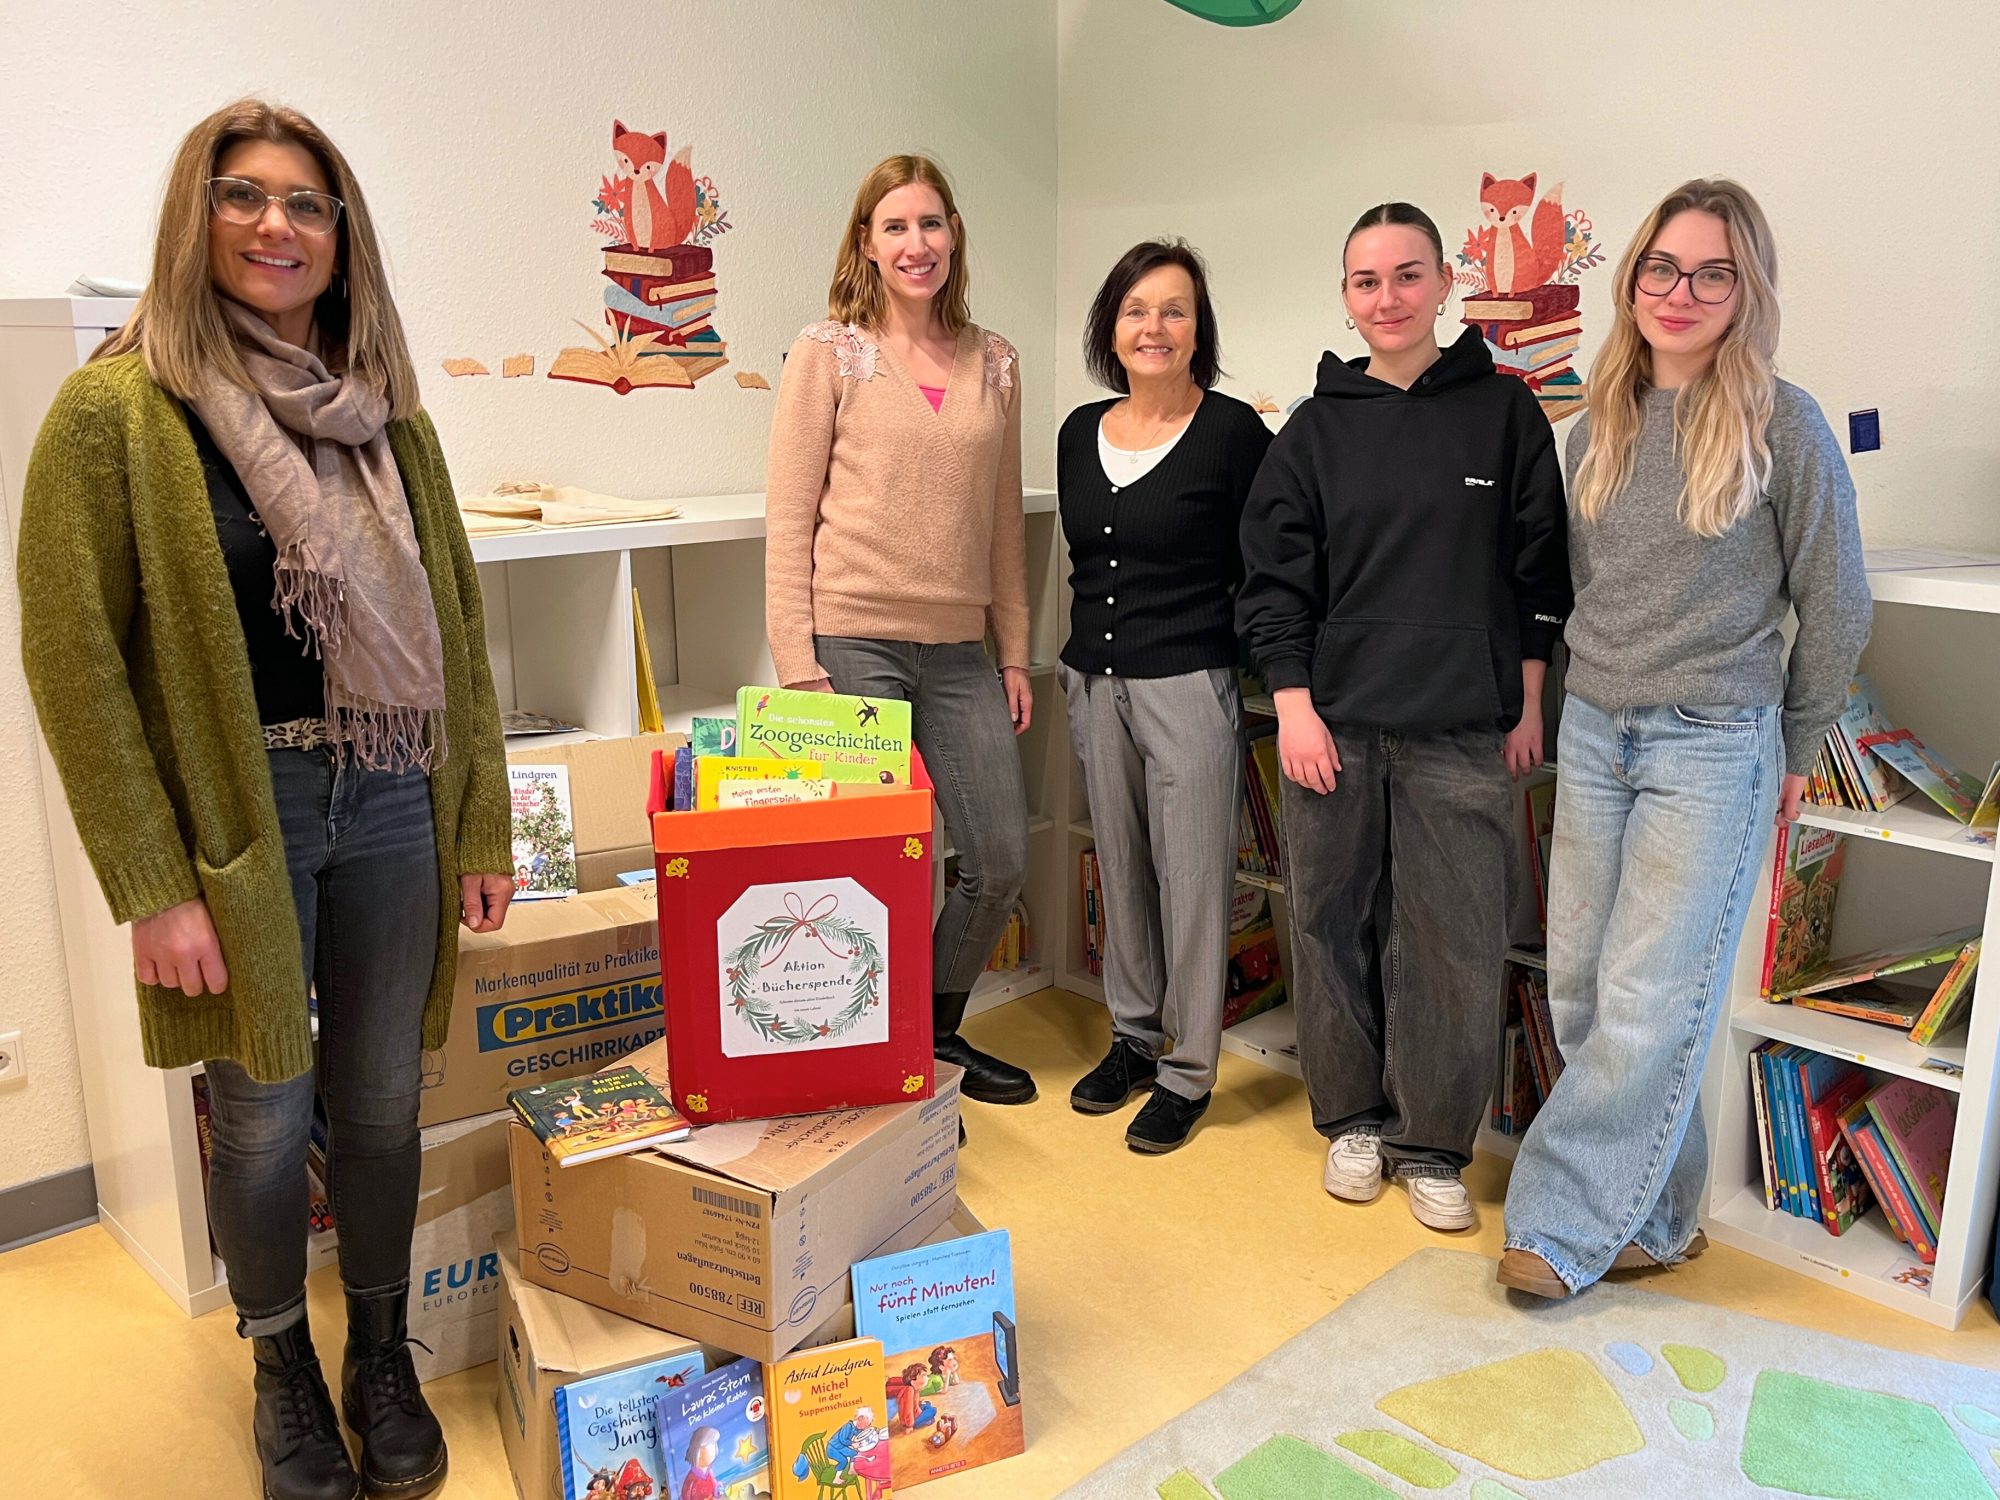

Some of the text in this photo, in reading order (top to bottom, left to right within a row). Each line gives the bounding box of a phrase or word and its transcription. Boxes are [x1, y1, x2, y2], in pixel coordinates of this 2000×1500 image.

[768, 713, 784, 724] Die
[750, 723, 903, 752] Zoogeschichten
[725, 765, 758, 773] KNISTER
[834, 751, 877, 765] Kinder
[511, 770, 557, 781] Lindgren
[513, 788, 535, 796] Kinder
[731, 785, 782, 798] Meine ersten
[1800, 829, 1836, 856] Lieselotte
[475, 946, 662, 994] Markenqualität zu Praktike
[783, 960, 826, 973] Aktion
[761, 975, 853, 994] Bücherspende
[196, 1113, 213, 1159] Aschenp
[940, 1166, 955, 1183] REF
[694, 1239, 708, 1250] blau
[701, 1232, 722, 1244] Karton
[423, 1252, 498, 1298] EUR
[676, 1251, 761, 1286] Bettschutzauflagen
[869, 1275, 914, 1295] Nur noch
[877, 1269, 996, 1313] fünf Minuten!
[689, 1281, 762, 1315] REF 788500
[896, 1298, 975, 1324] Spielen statt fernsehen
[784, 1358, 875, 1385] Astrid Lindgren
[682, 1390, 717, 1416] Lauras
[718, 1373, 751, 1397] Stern
[811, 1378, 849, 1396] Michel
[819, 1392, 842, 1402] in der
[595, 1394, 659, 1420] Die tollsten
[688, 1413, 702, 1427] Die
[702, 1401, 726, 1419] kleine
[798, 1396, 863, 1418] Suppenschüssel
[608, 1429, 659, 1452] Jung
